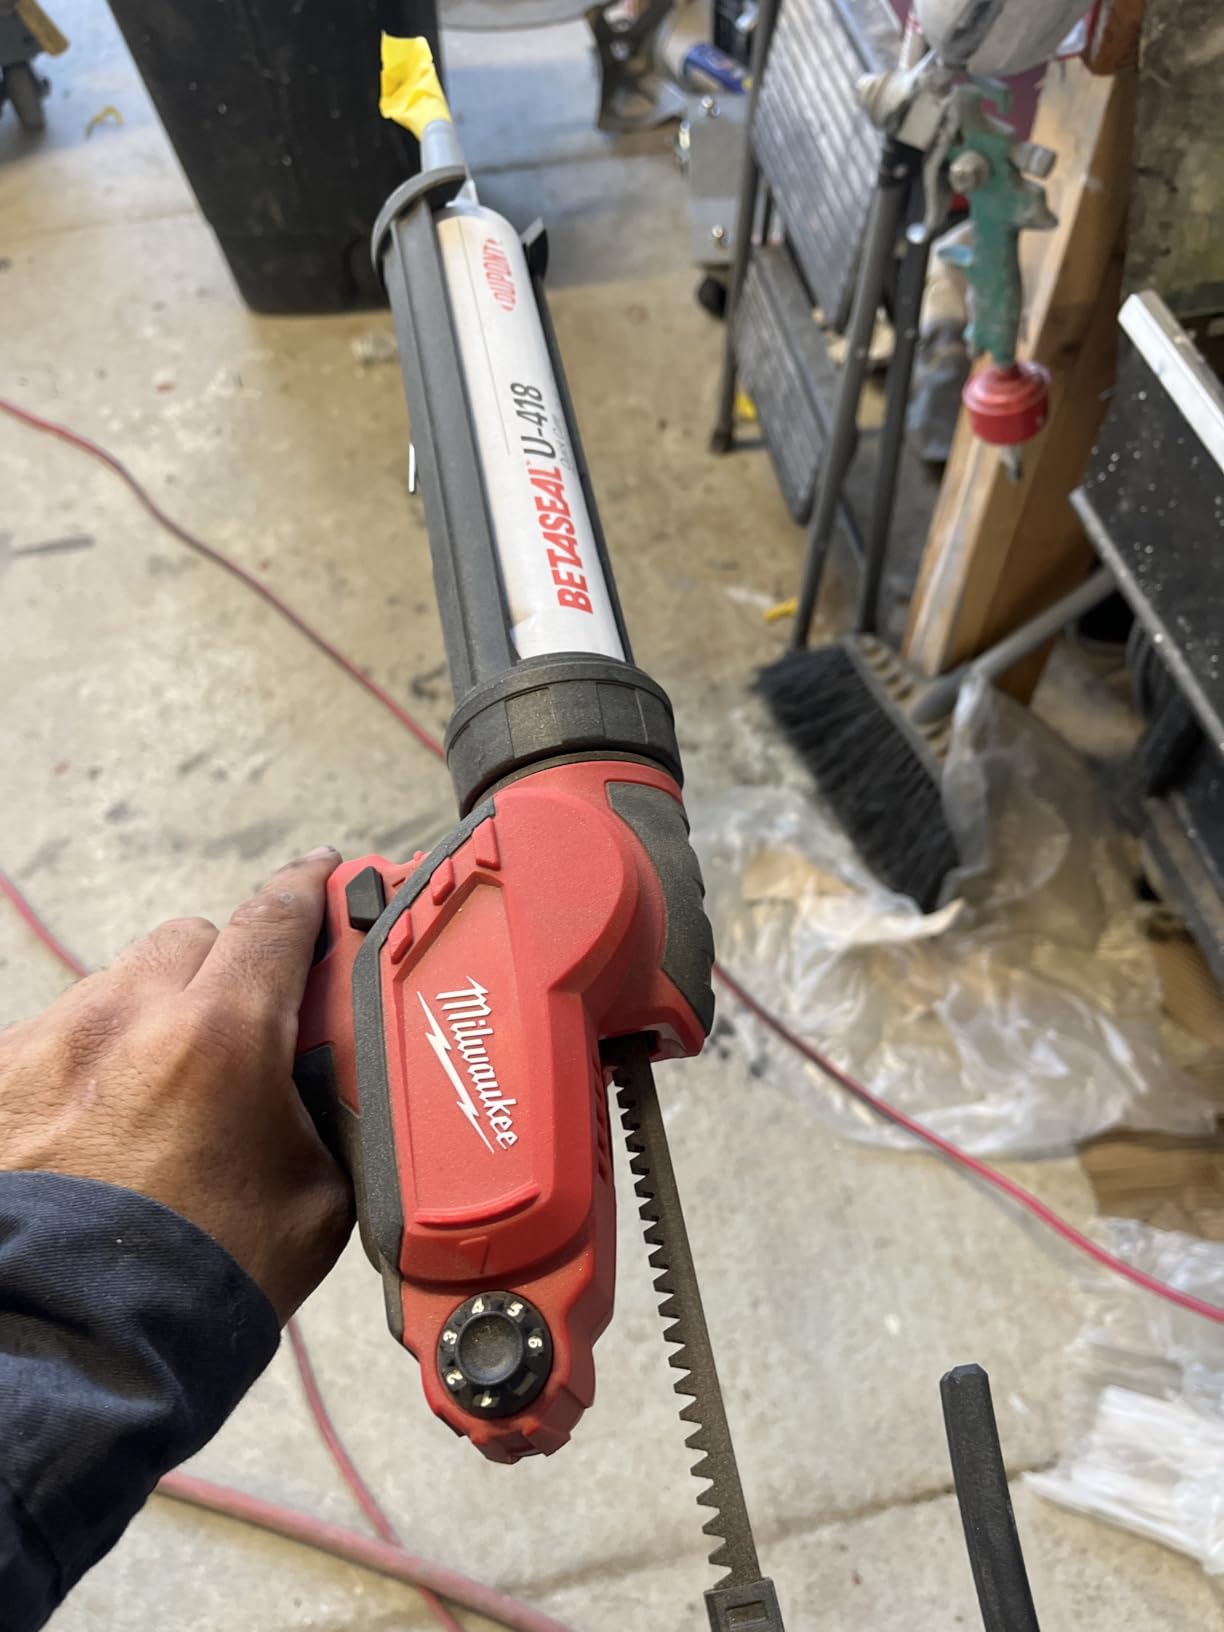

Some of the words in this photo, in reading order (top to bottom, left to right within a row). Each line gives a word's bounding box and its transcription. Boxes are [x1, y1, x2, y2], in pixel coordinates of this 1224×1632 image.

[482, 240, 516, 307] DUPONT
[510, 382, 556, 459] U-418
[527, 467, 593, 614] BETASEAL
[435, 976, 519, 1150] Milwaukee
[472, 1297, 485, 1314] 4
[506, 1301, 524, 1317] 5
[443, 1330, 458, 1345] 3
[528, 1336, 543, 1349] 6
[446, 1370, 463, 1385] 2
